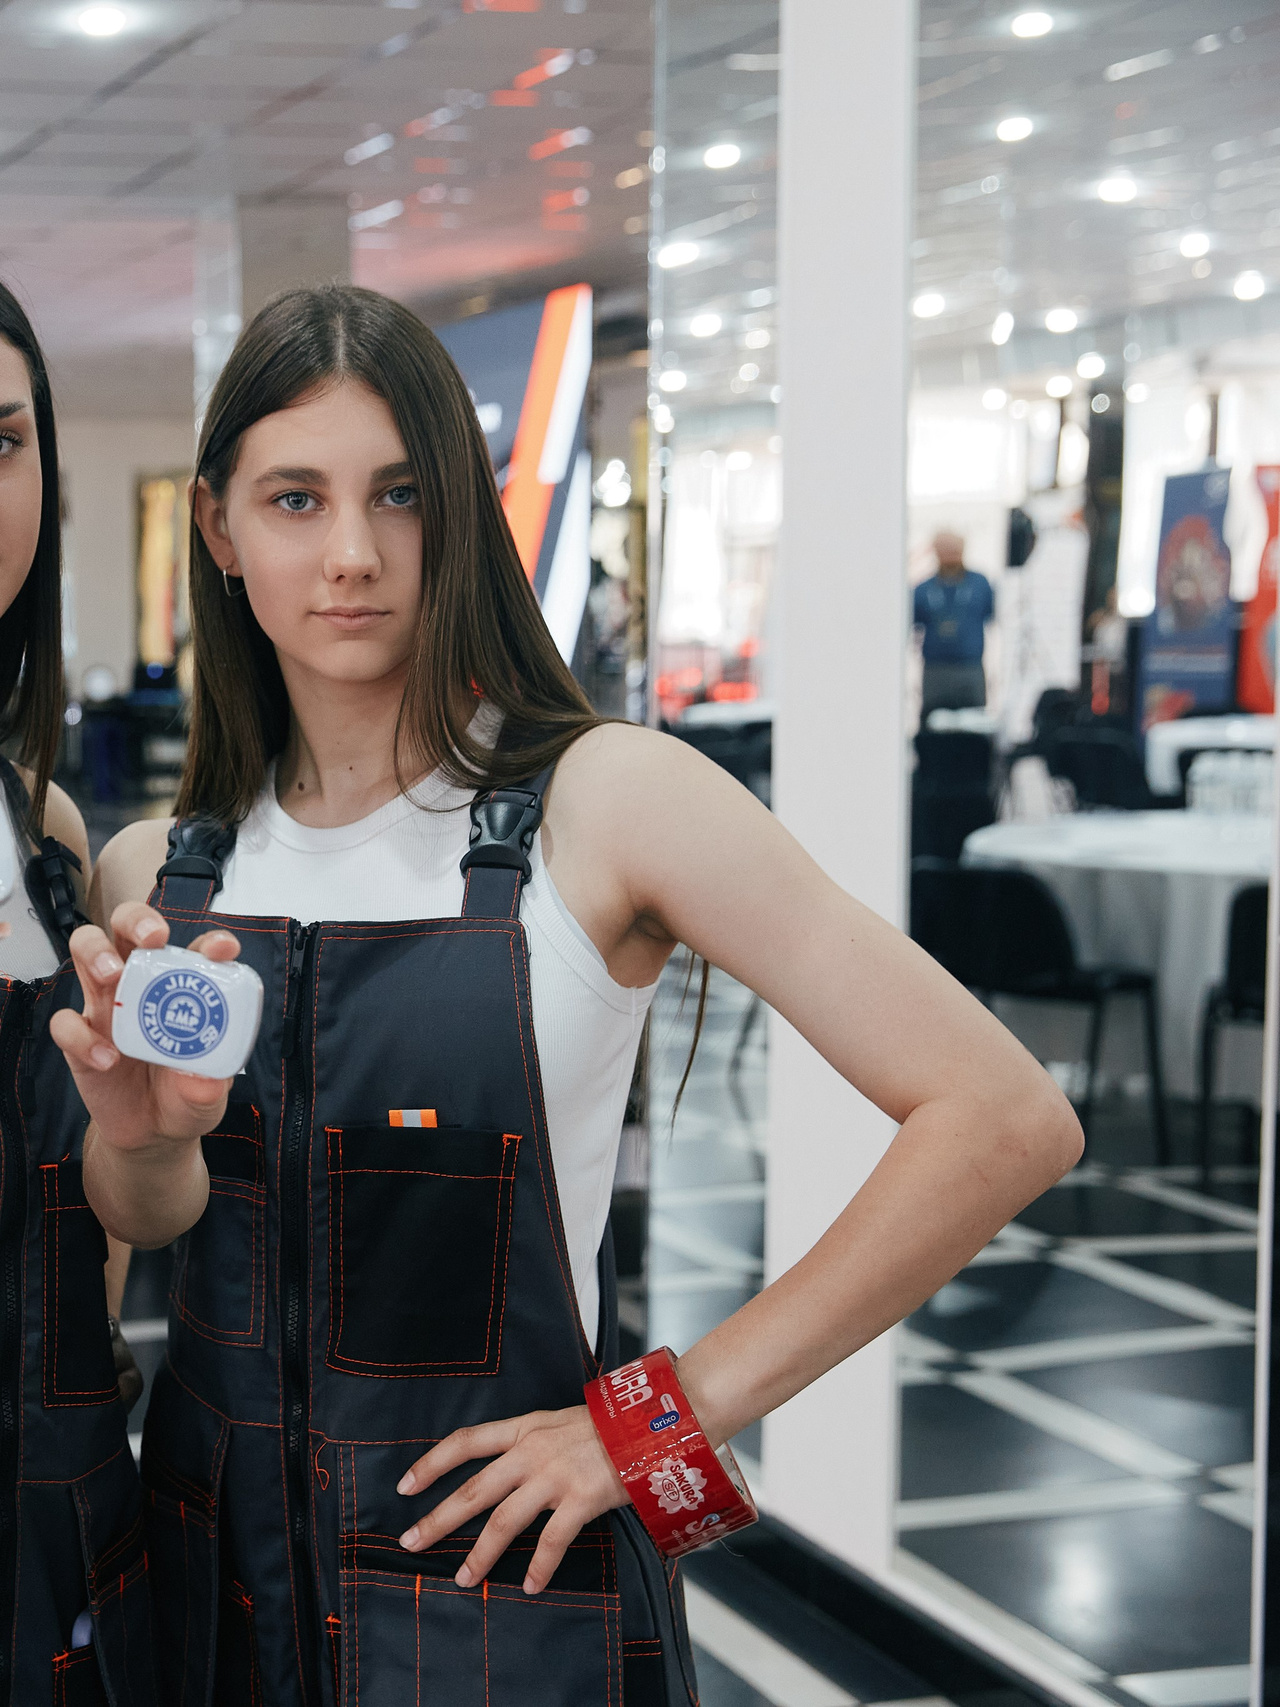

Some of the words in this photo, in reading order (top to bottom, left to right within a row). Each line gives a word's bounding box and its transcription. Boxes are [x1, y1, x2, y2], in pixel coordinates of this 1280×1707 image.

[165, 974, 220, 1008] JIKIU
[653, 1414, 677, 1430] brixo
[665, 1481, 679, 1498] S/F
[669, 1465, 699, 1505] SAKURA
